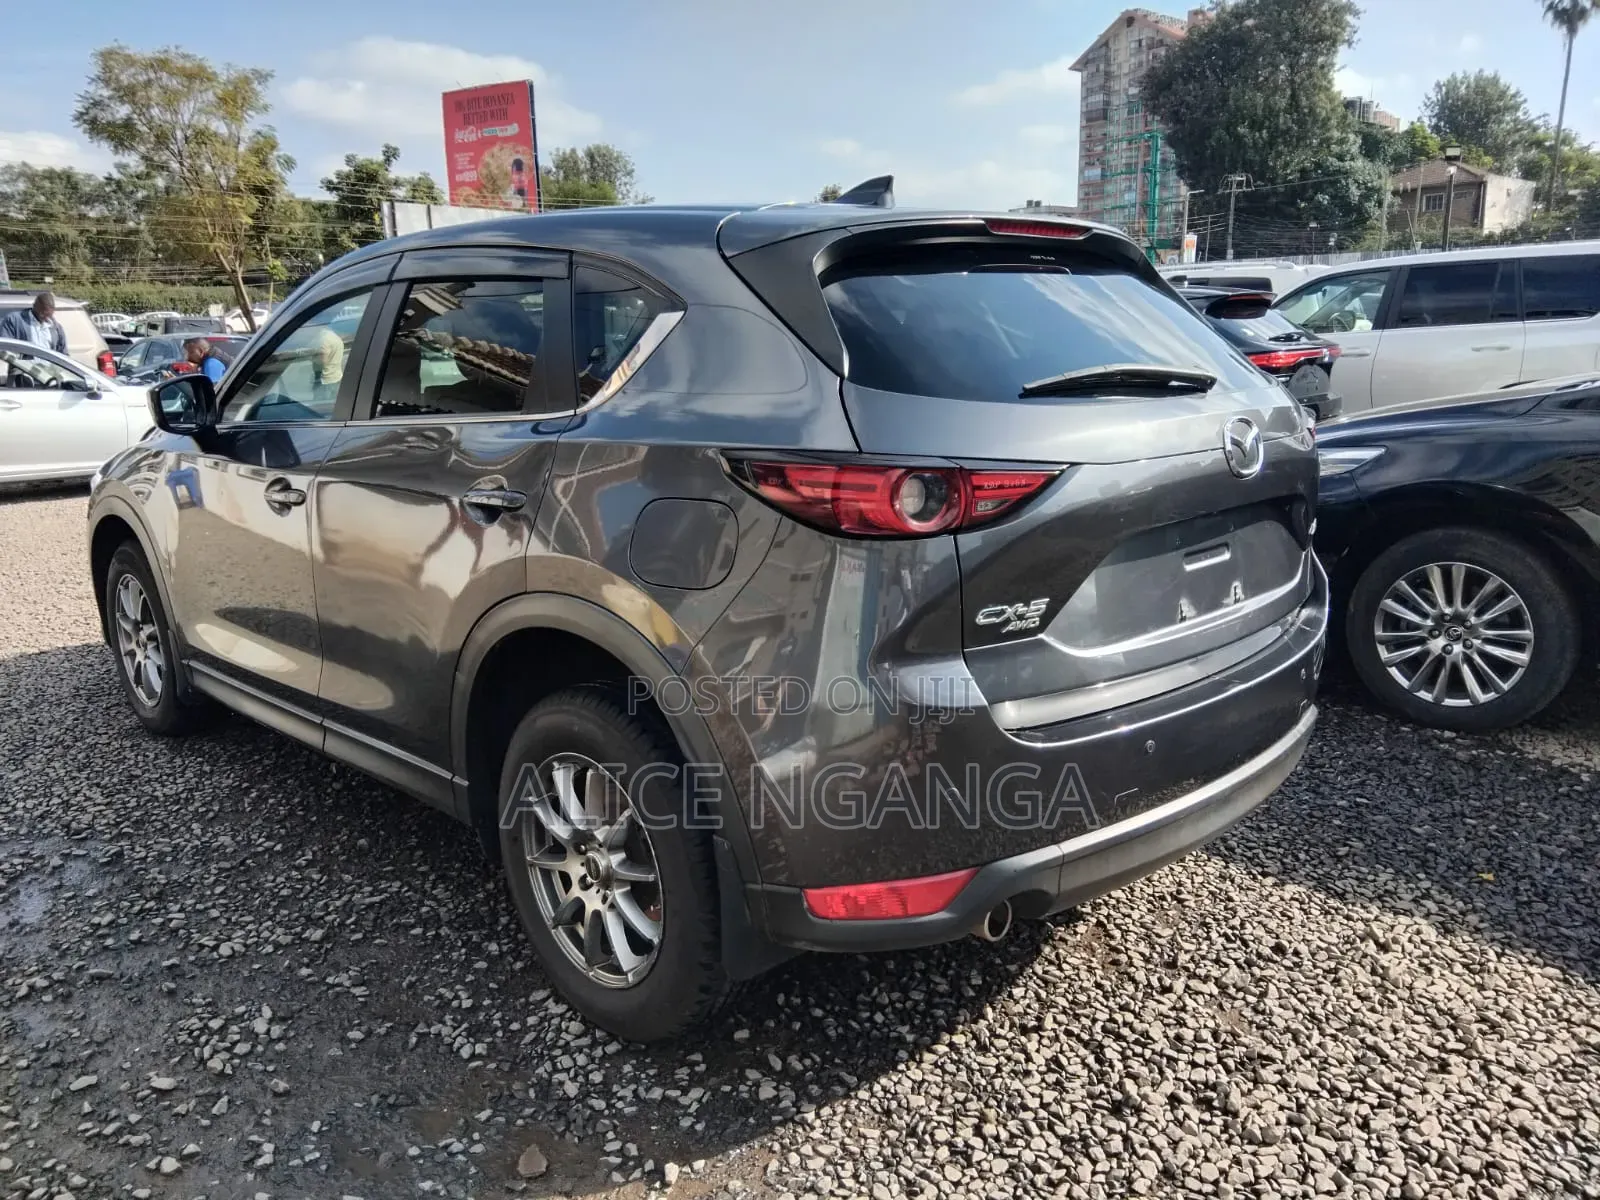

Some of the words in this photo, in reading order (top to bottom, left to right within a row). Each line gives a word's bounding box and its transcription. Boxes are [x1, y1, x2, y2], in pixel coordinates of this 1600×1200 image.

[483, 92, 515, 108] BONANZA
[463, 110, 488, 126] BETTER
[490, 108, 508, 121] WITH
[976, 598, 1050, 625] CX-5
[1001, 617, 1040, 633] AWD
